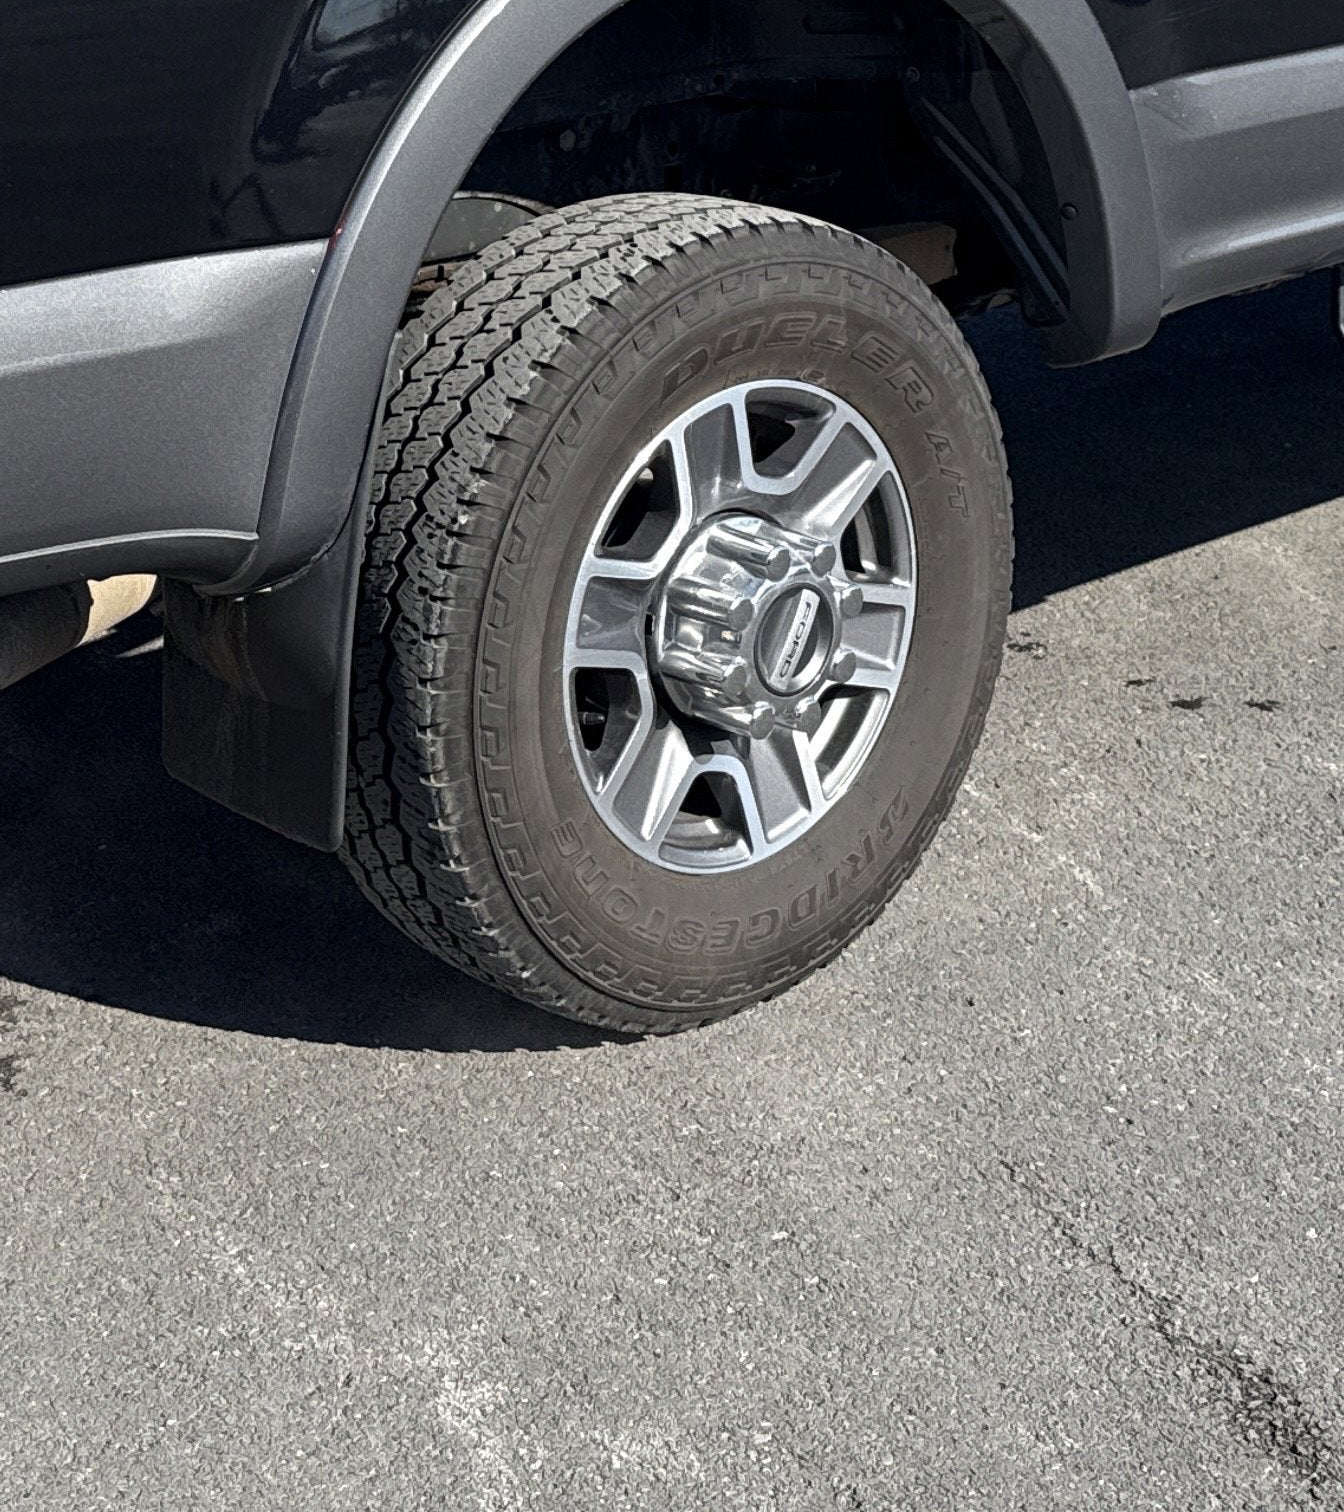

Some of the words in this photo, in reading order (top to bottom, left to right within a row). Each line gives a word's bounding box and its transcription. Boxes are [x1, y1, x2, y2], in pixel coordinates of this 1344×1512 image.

[658, 312, 934, 414] DUELER
[925, 430, 970, 519] A/T
[779, 600, 812, 678] FORD
[550, 784, 910, 957] BRIDGESTONE
